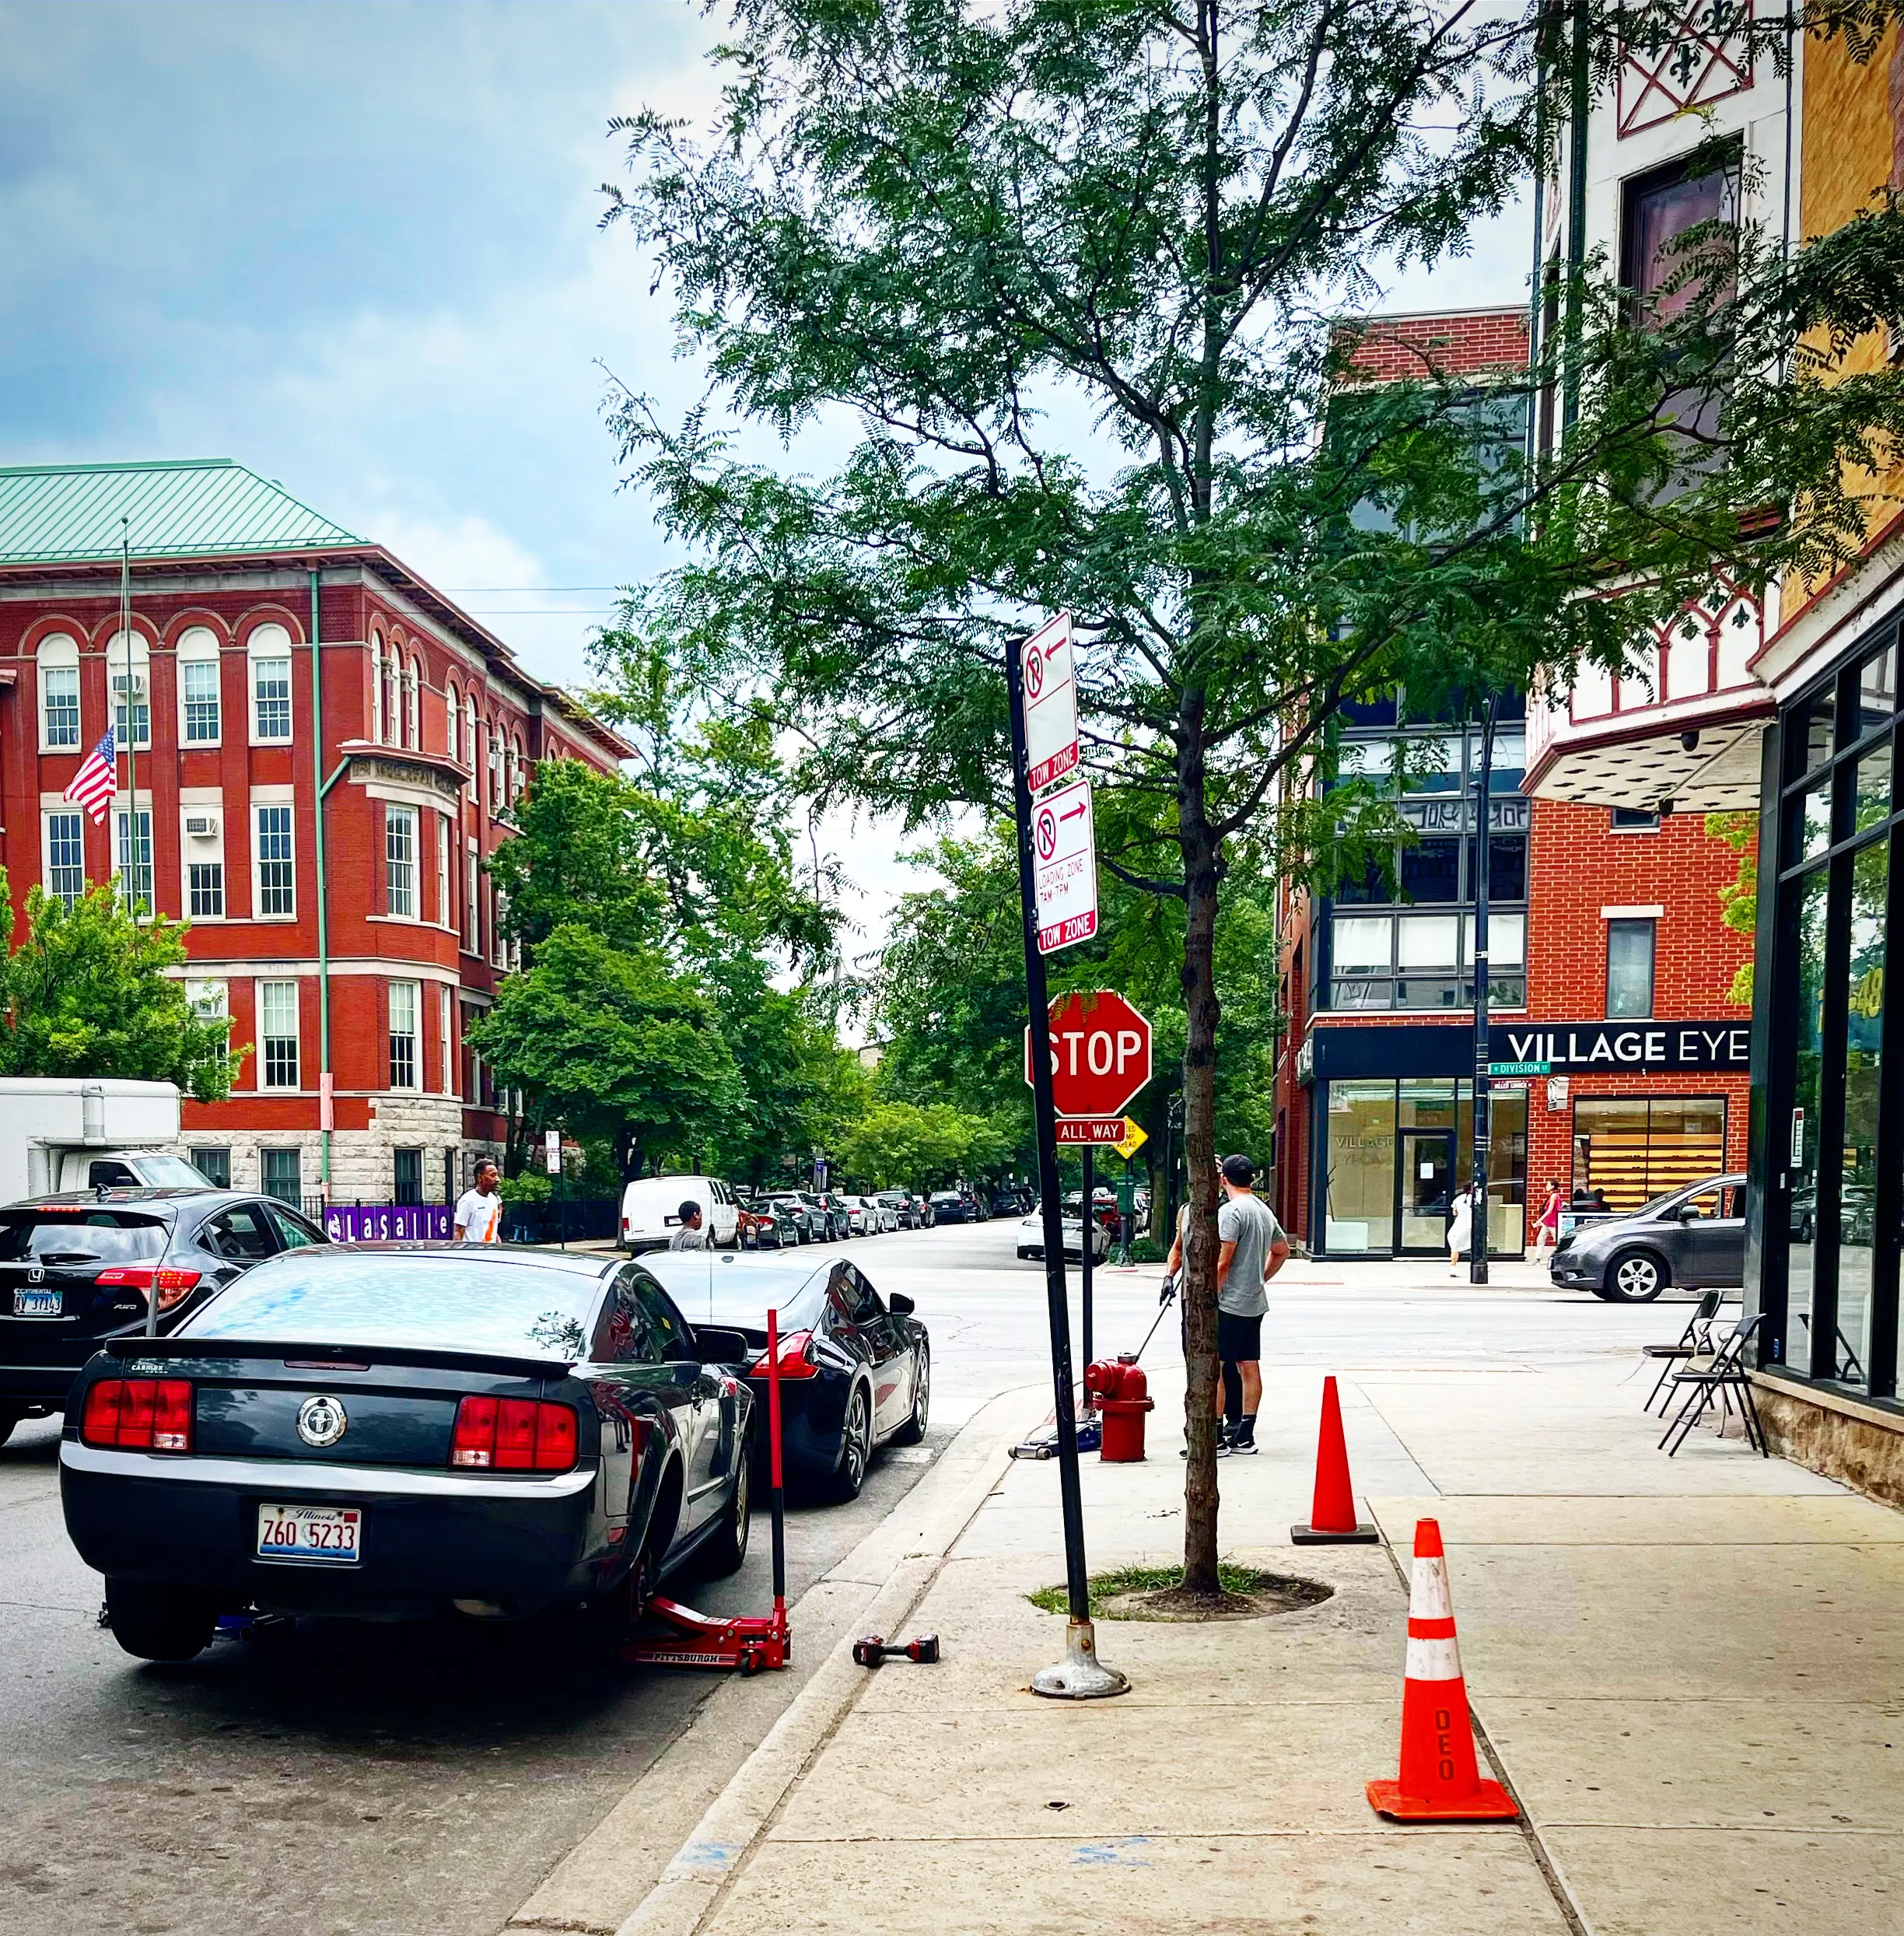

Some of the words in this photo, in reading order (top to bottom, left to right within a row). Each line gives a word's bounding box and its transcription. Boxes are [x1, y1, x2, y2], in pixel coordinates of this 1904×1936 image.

[1031, 762, 1050, 787] TOW
[1052, 746, 1075, 776] ZONE
[1039, 867, 1064, 889] LOADING
[1067, 858, 1083, 877] ZONE
[1041, 926, 1061, 948] TOW
[1065, 914, 1091, 940] ZONE
[1508, 1032, 1666, 1063] VILLAGE
[1679, 1030, 1749, 1060] EYE
[1500, 1063, 1540, 1073] DIVISION
[1061, 1125, 1087, 1139] ALL
[1092, 1124, 1119, 1138] WAY
[1335, 1136, 1394, 1148] VILLAGE
[15, 1295, 27, 1311] AV
[32, 1297, 61, 1311] 37143
[292, 1509, 336, 1521] Illinois
[263, 1519, 296, 1546] Z60
[309, 1523, 355, 1549] 5233
[653, 1653, 719, 1663] PITTSBURGH
